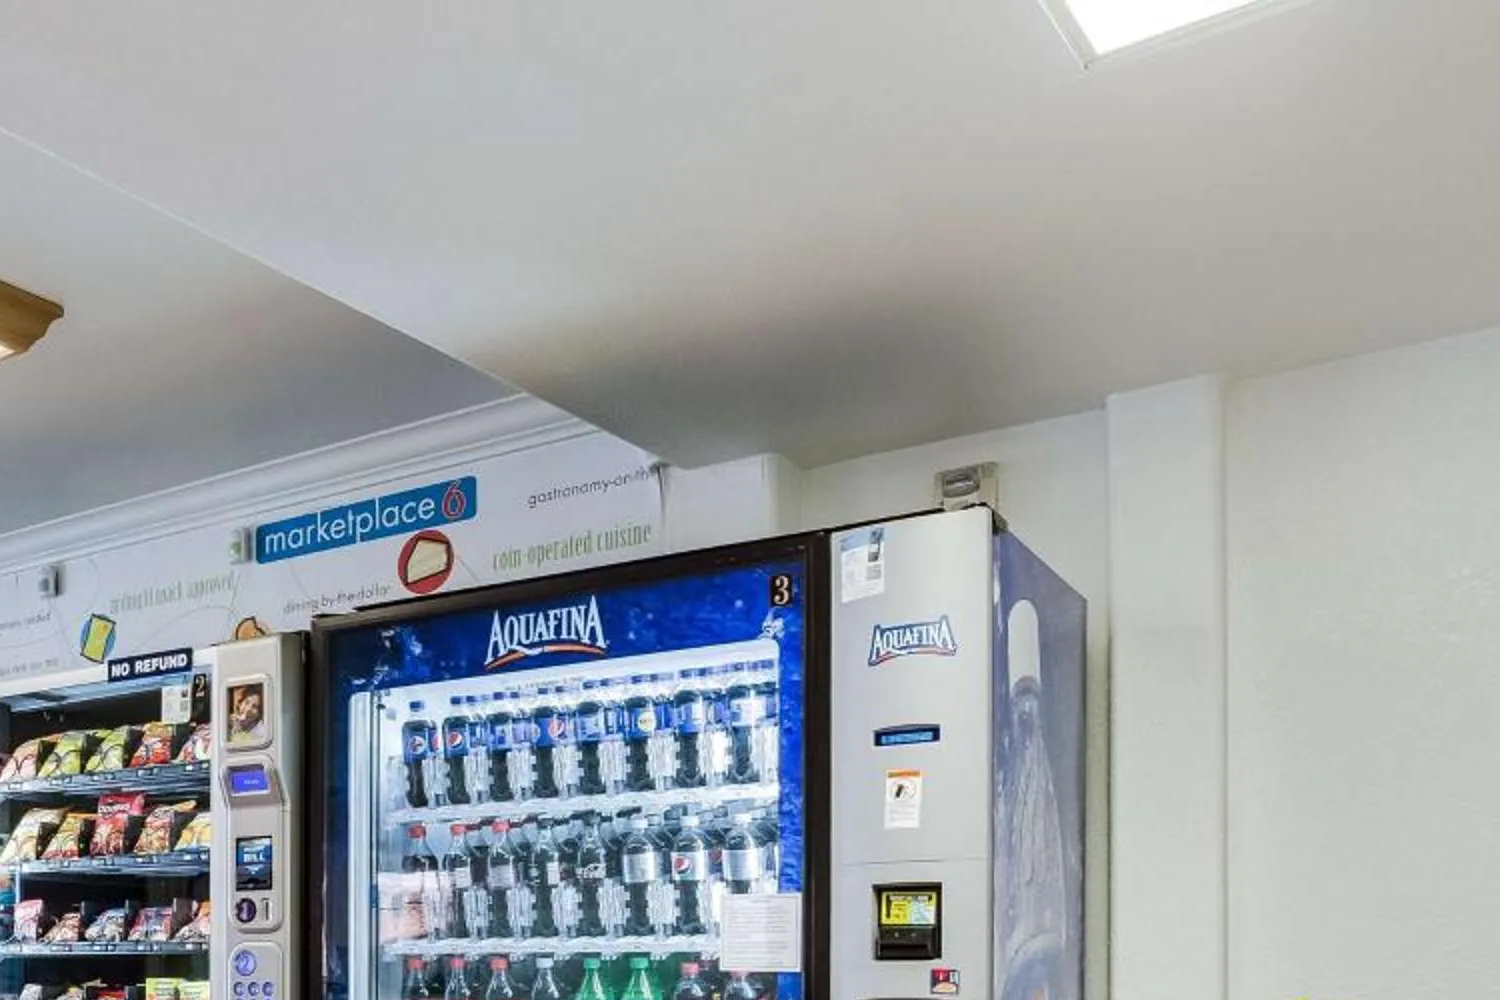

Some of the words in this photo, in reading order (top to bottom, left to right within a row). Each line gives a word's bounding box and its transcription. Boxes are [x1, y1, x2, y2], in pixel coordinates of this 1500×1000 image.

[265, 497, 435, 554] marketplace
[442, 479, 466, 519] 6
[492, 530, 592, 571] coin-operated
[597, 522, 651, 551] cuisine
[774, 575, 789, 604] 3
[484, 594, 607, 665] AQUAFINA
[869, 616, 956, 664] AQUAFINA
[111, 662, 130, 678] NO
[135, 653, 188, 674] REFUND
[195, 675, 206, 697] 2
